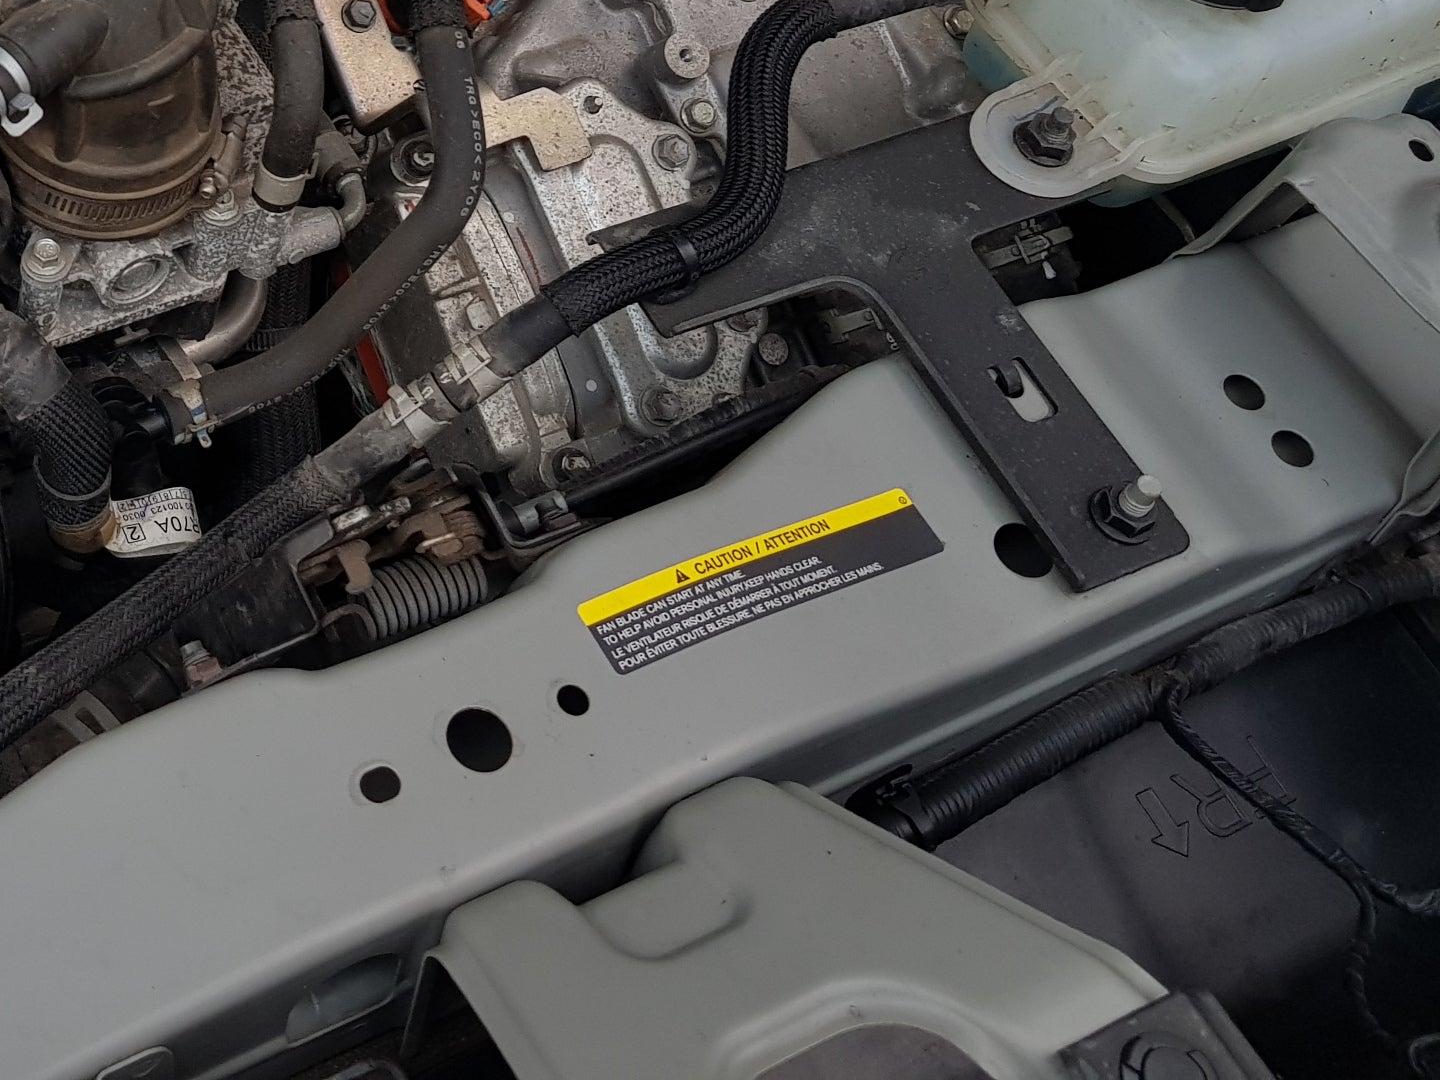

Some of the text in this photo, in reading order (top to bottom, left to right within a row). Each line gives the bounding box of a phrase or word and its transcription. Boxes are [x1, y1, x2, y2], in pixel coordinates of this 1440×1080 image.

[463, 76, 477, 105] TRG
[126, 526, 141, 541] 2
[150, 501, 183, 515] 100123
[693, 544, 753, 575] CAUTION
[763, 518, 830, 551] ATTENTION
[596, 620, 616, 635] FAN
[616, 608, 646, 627] BLADE
[646, 599, 667, 615] CAN
[666, 589, 694, 607] START
[694, 584, 706, 596] AT
[705, 576, 725, 591] ANY
[602, 633, 619, 647] TO
[618, 623, 643, 641] HELP
[641, 613, 671, 631] AVOID
[670, 594, 718, 620] PERSONAL
[764, 564, 795, 583] HANDS
[793, 554, 822, 572] CLEAR.
[611, 646, 625, 659] LE
[624, 623, 683, 654] VENTILATEUR
[682, 611, 715, 631] RISQUE
[714, 605, 729, 619] DE
[728, 587, 774, 613] DÉMARRER
[780, 578, 801, 593] TOUT
[799, 564, 837, 585] MOMENT.
[618, 560, 884, 670] POUR ÉVITER TOUTE BLESSURE, NE PAS EN APPROCHER LES MAINS.
